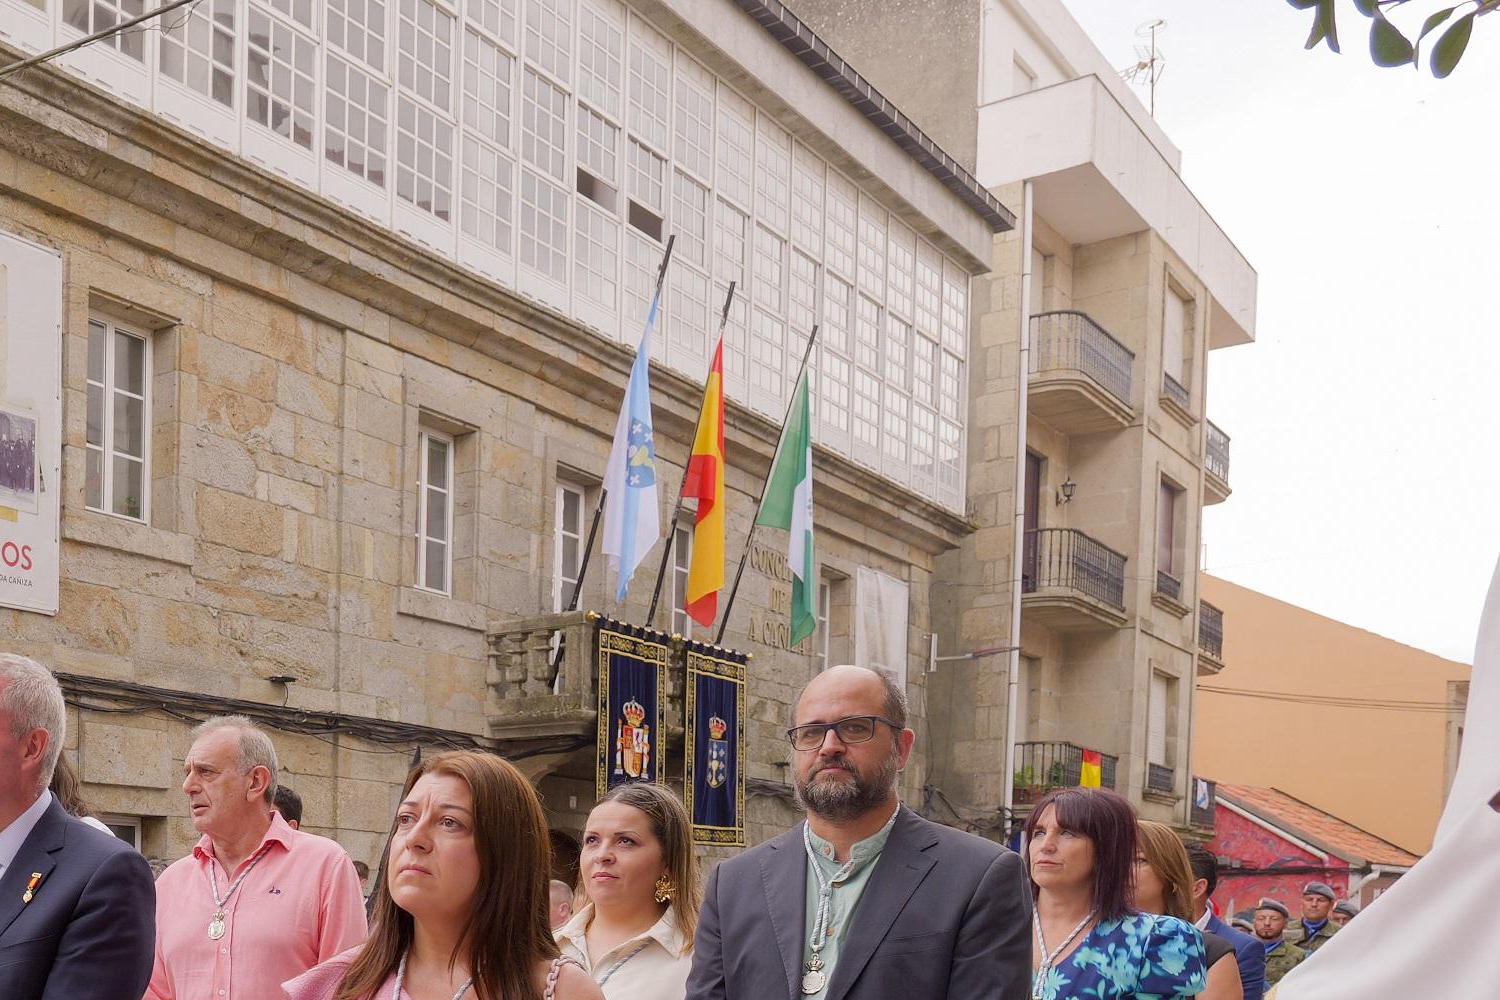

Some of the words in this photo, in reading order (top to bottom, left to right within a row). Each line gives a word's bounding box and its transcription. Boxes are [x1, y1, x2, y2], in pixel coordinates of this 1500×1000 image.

[8, 576, 33, 587] CAÑIZA
[771, 587, 786, 616] DE
[747, 616, 756, 642] A
